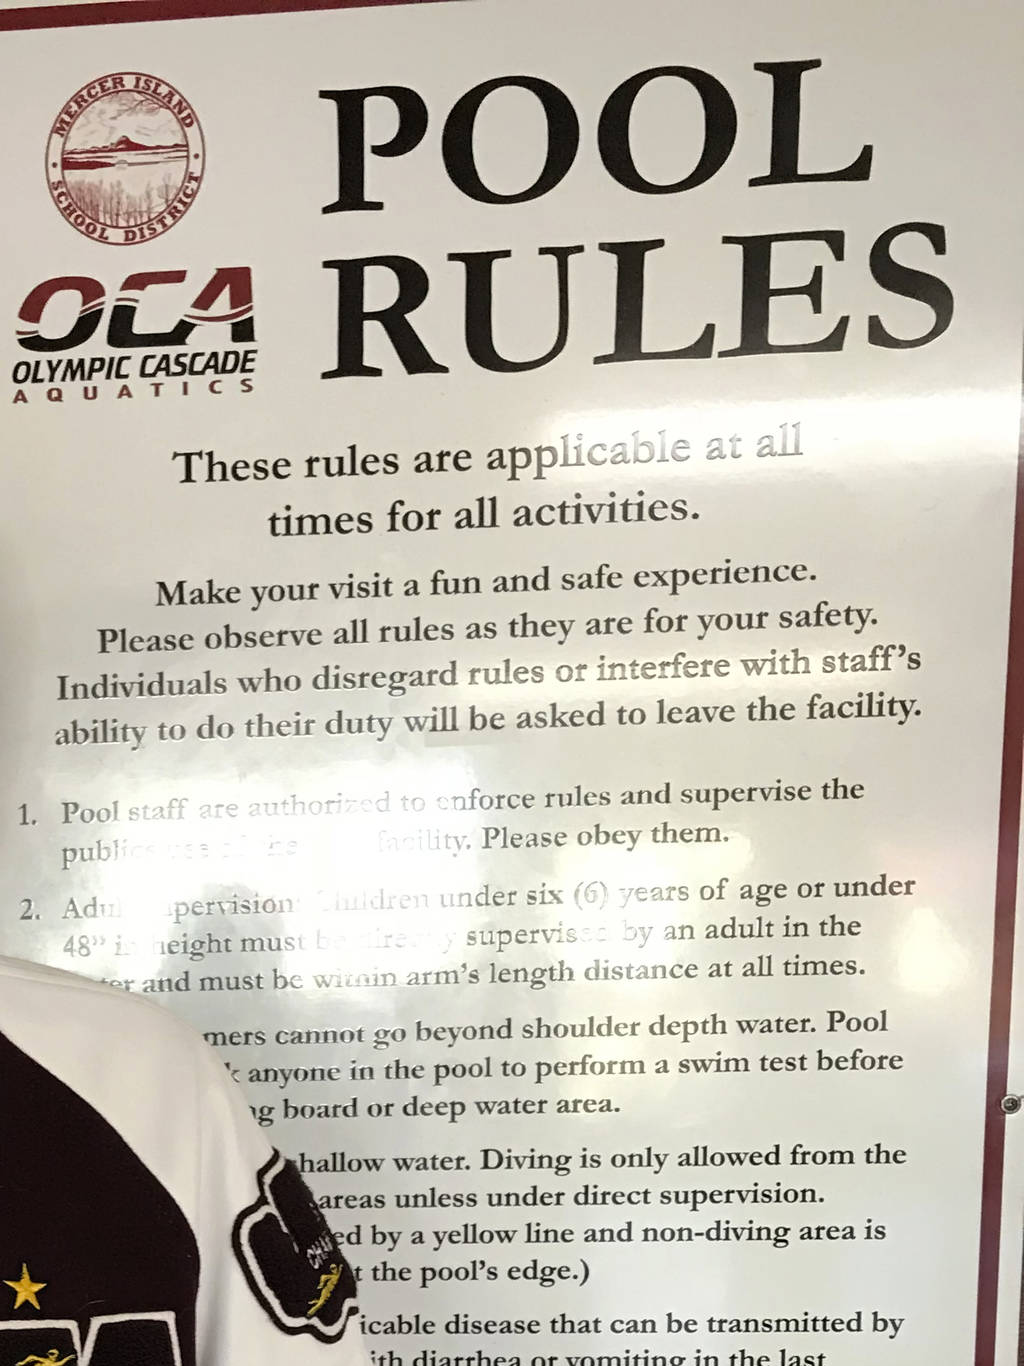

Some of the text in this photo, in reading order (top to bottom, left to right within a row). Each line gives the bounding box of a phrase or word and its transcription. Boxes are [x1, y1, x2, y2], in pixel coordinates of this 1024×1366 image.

[53, 76, 195, 138] MERCER ISLAND
[319, 58, 873, 215] POOL
[50, 171, 201, 242] SCHOOL DISTRICT
[15, 266, 258, 352] OCA
[322, 221, 954, 379] RULES
[12, 349, 258, 384] OLYMPIC CASCADE
[171, 422, 803, 484] These rules are applicable all
[267, 490, 699, 537] times for all activities.
[155, 558, 816, 612] Make your visit fun and safe experience.
[96, 600, 878, 654] Please observe all rules they are for your safety.
[56, 670, 228, 702] Individuals
[236, 667, 302, 693] who
[312, 660, 459, 697] disregard
[468, 658, 544, 685] rules
[596, 652, 730, 681] interfere
[739, 648, 811, 676] with
[54, 691, 921, 751] ability their duty will asked leave the facility.
[543, 777, 865, 811] rules and supervise the
[481, 820, 730, 852] Please obey them.
[742, 953, 867, 977] all times.
[274, 1009, 889, 1048] cannot beyond shoulder depth water. Pool
[248, 1063, 341, 1088] anyone
[384, 1058, 425, 1079] the
[433, 1058, 492, 1086] pool
[534, 1054, 646, 1084] perform
[678, 1051, 751, 1073] swim
[759, 1052, 808, 1072] test
[816, 1048, 904, 1071] before
[283, 1096, 358, 1120] board
[402, 1096, 467, 1122] deep
[475, 1096, 548, 1115] water
[555, 1097, 621, 1114] area.
[392, 1143, 908, 1176] water. Diving only allowed from the
[318, 1181, 825, 1212] areas unless under direct supervision.
[432, 1219, 857, 1252] yellow line and non-diving area
[371, 1260, 413, 1282] the
[506, 1258, 591, 1288] edge.)
[444, 1311, 864, 1335] disease that can transmitted
